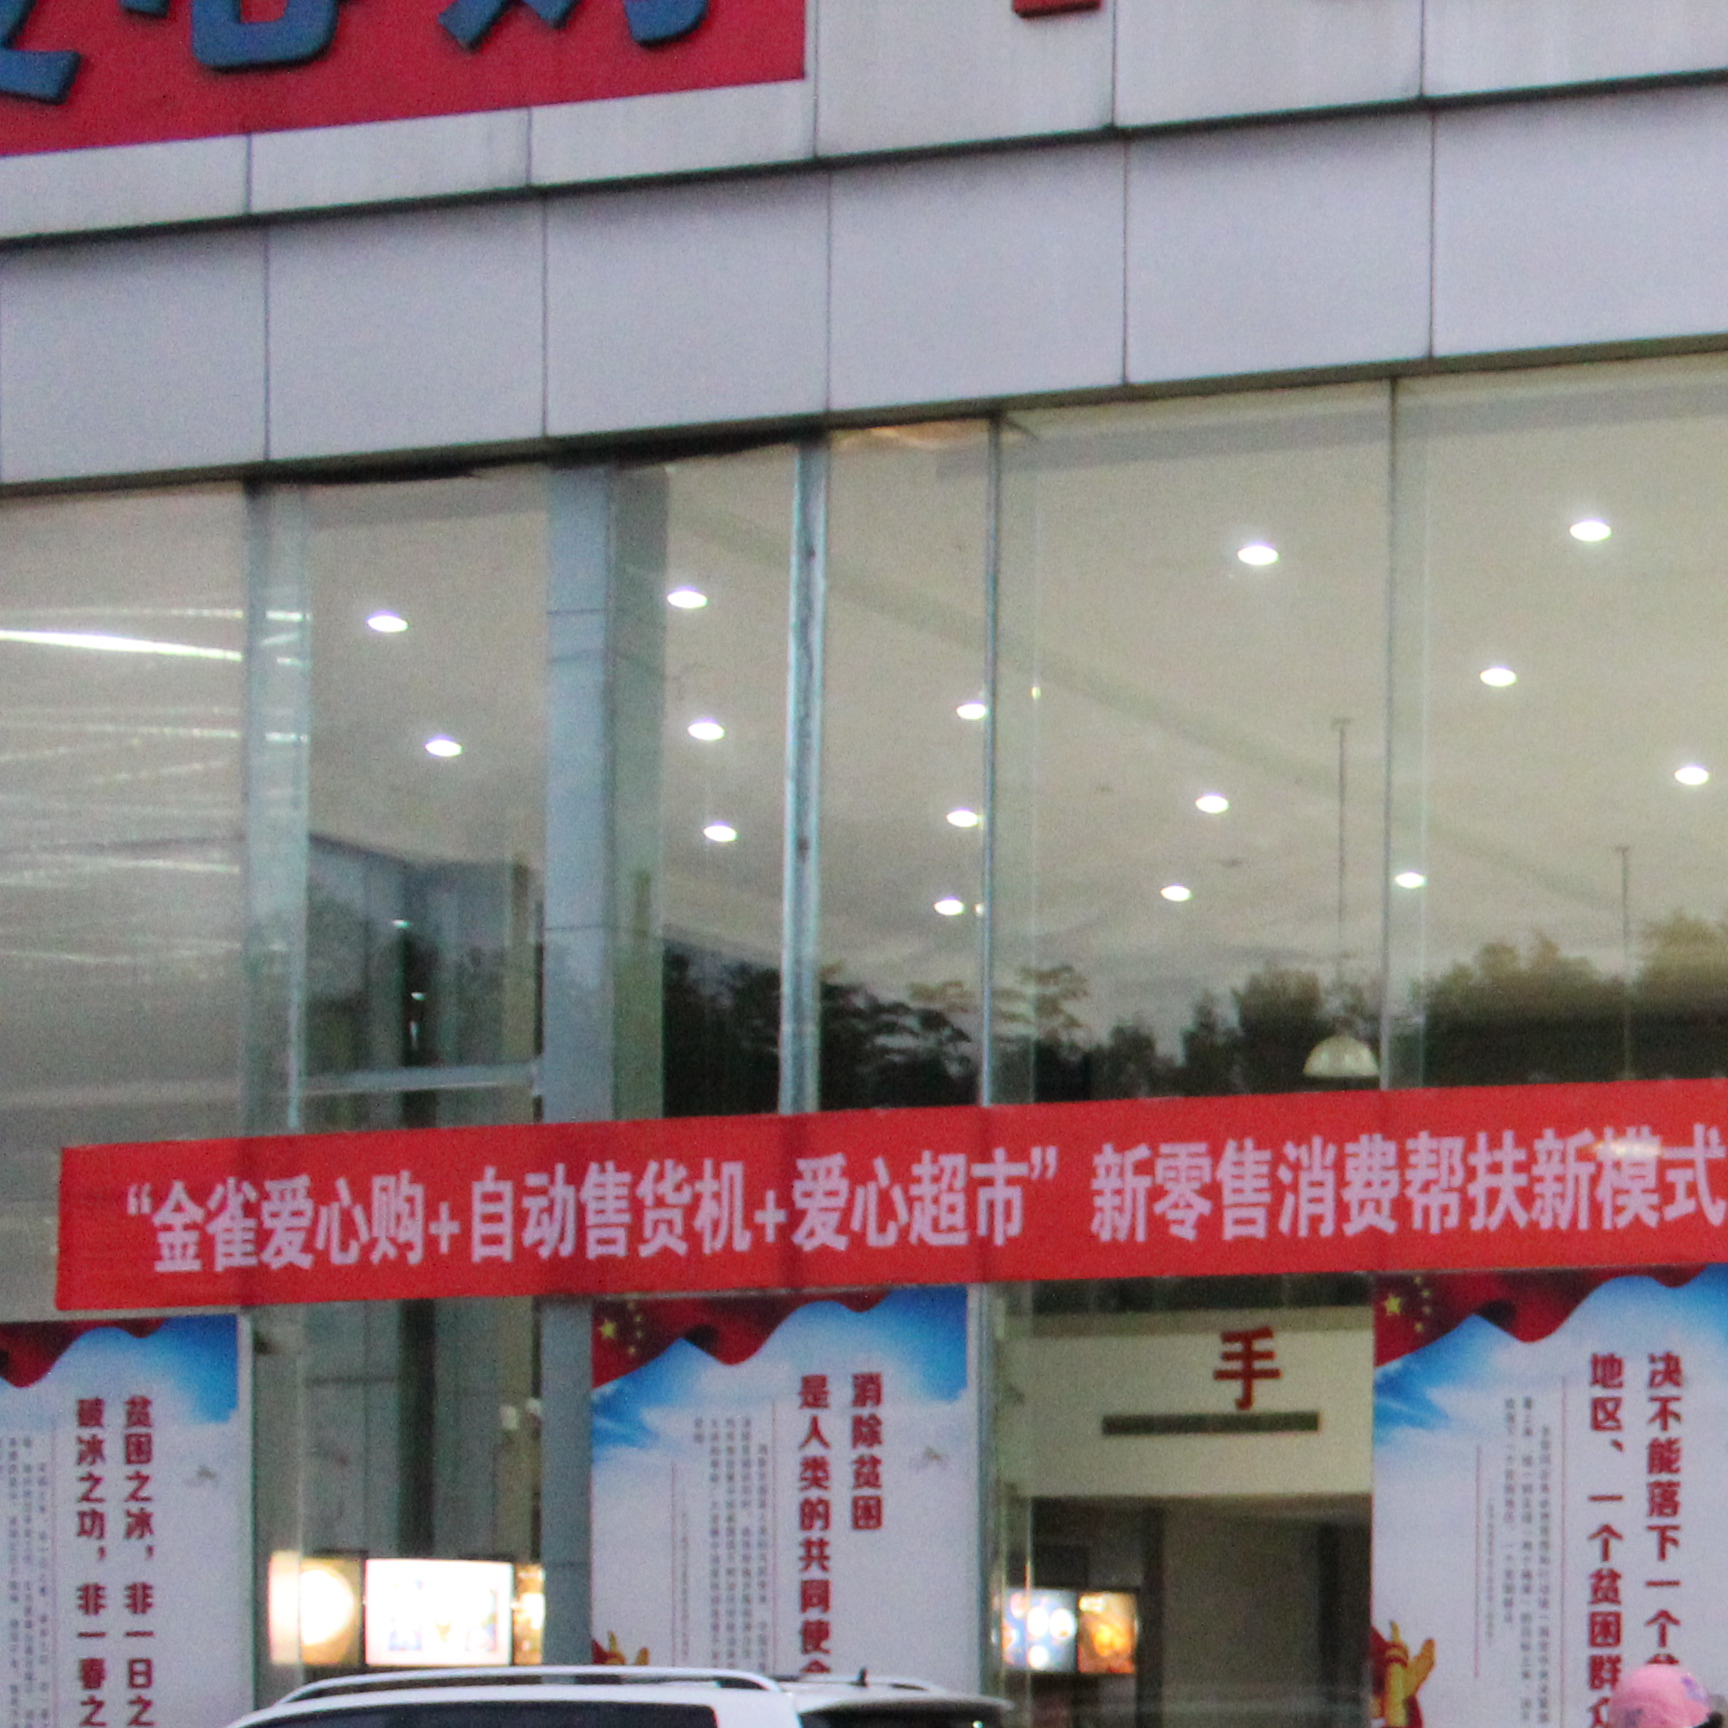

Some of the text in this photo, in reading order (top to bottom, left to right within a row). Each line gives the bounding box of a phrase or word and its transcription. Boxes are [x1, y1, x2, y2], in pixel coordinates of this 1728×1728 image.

[1089, 1121, 1728, 1244] 新零售消费帮扶新模式
[1211, 1326, 1283, 1411] 手
[851, 1371, 885, 1531] 消除贫困
[1643, 1350, 1685, 1664] 决不能落下一个
